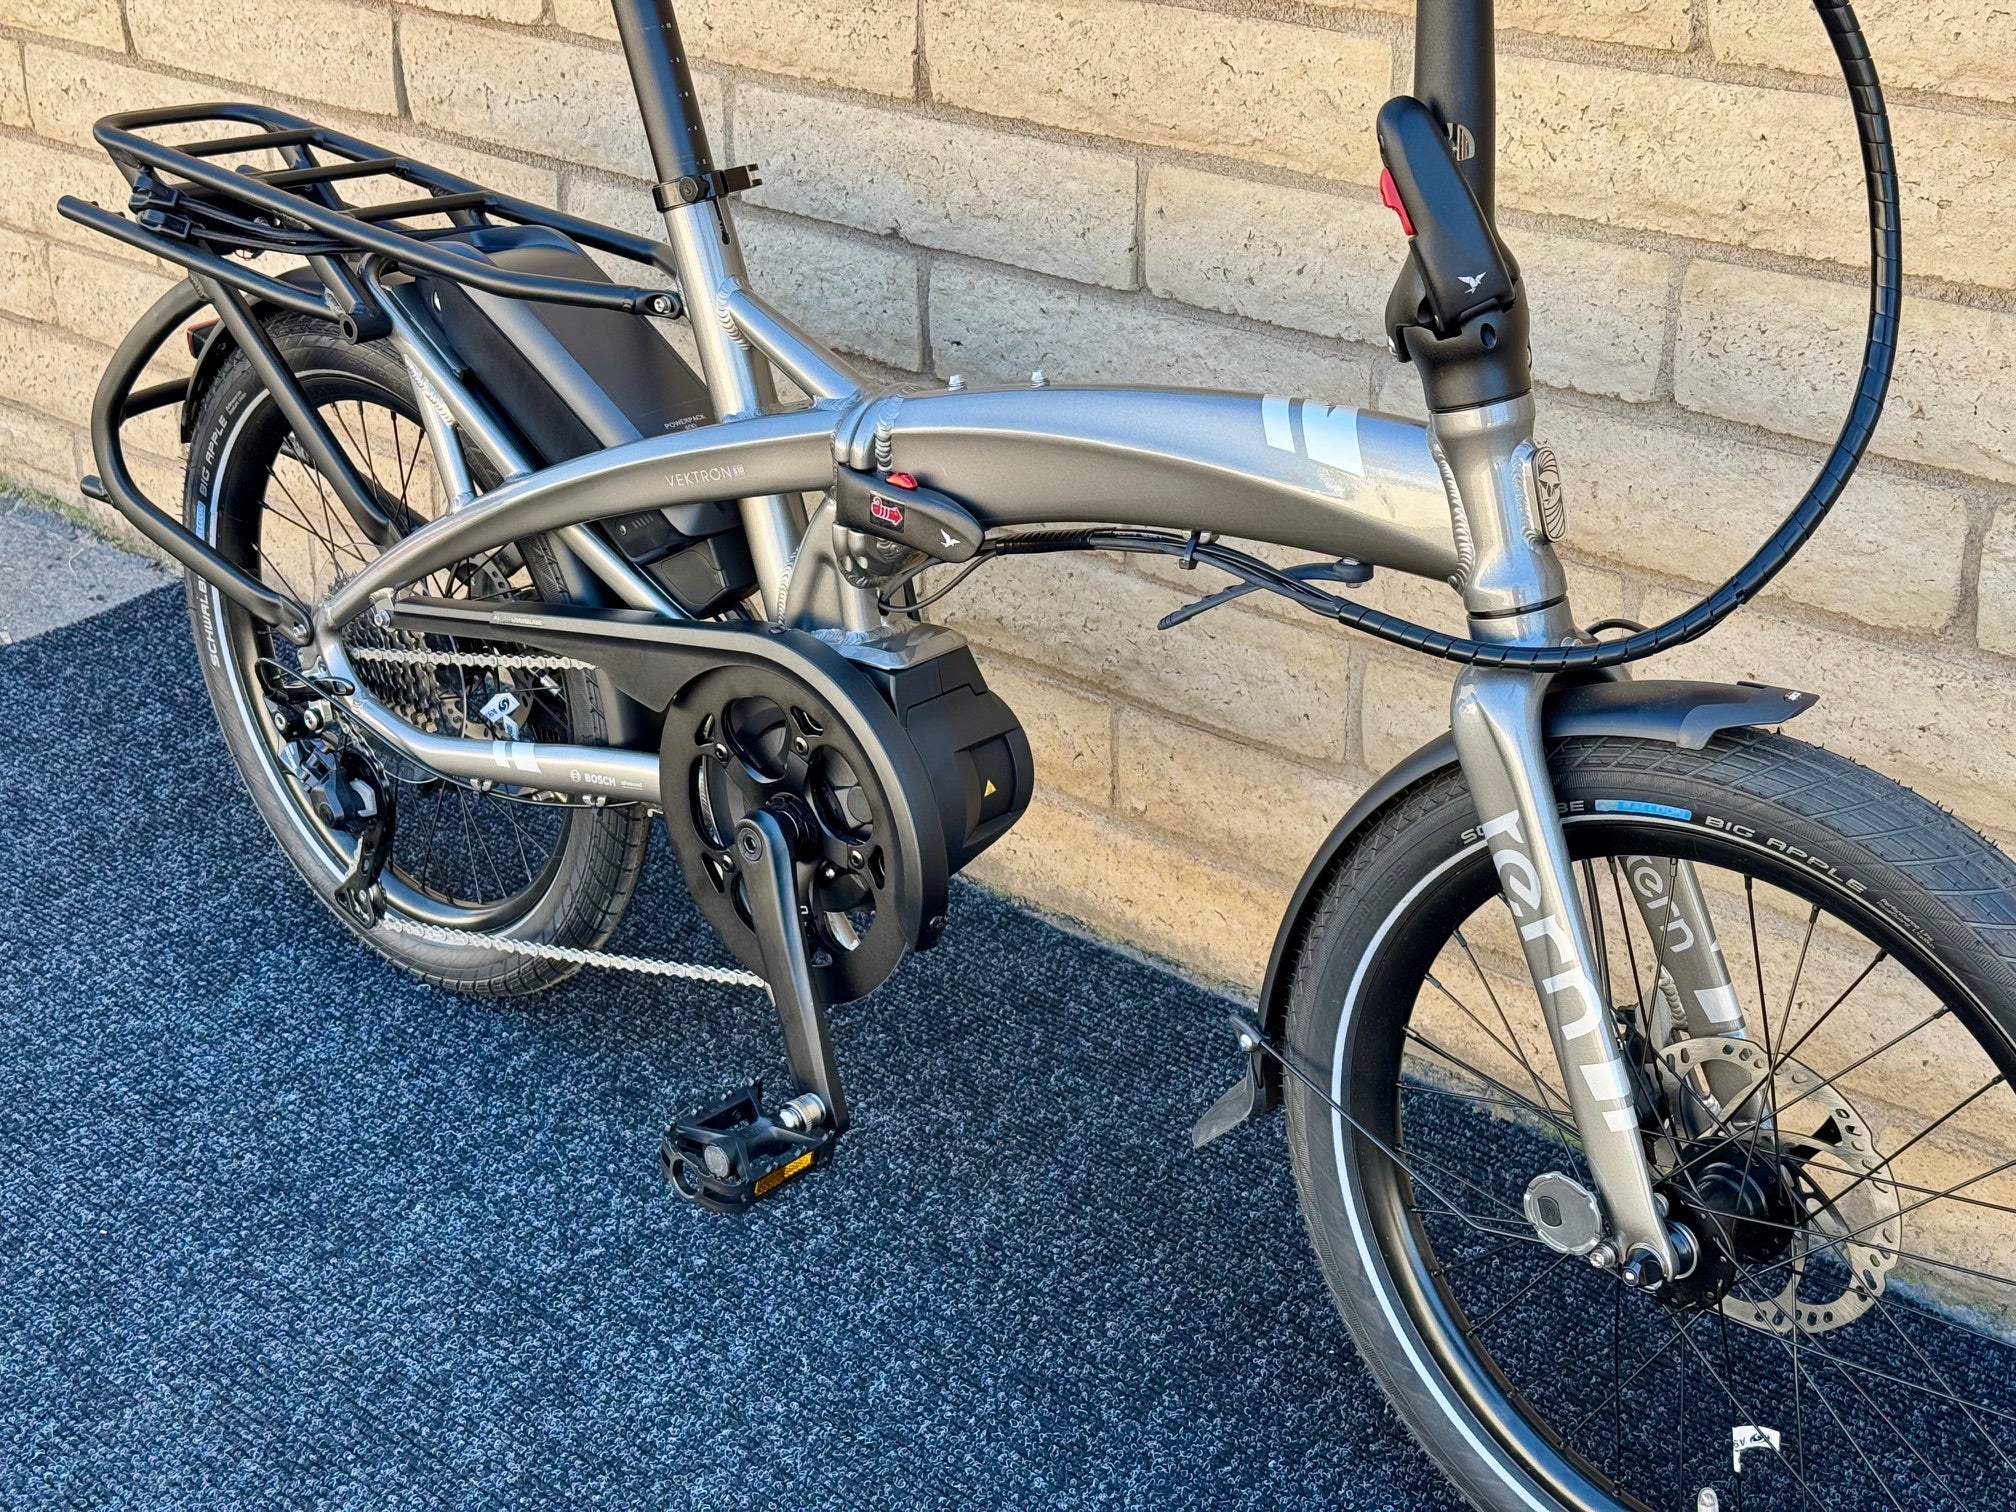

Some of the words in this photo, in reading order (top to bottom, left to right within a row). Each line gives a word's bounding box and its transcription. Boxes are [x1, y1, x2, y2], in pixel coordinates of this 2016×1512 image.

[664, 414, 707, 430] POWERPACK
[200, 469, 210, 497] BIG
[207, 415, 228, 463] APPLE
[665, 466, 732, 487] VEKTRON
[584, 772, 616, 787] BOSCH
[1705, 816, 1755, 838] BIG
[1767, 837, 1868, 894] APPLE
